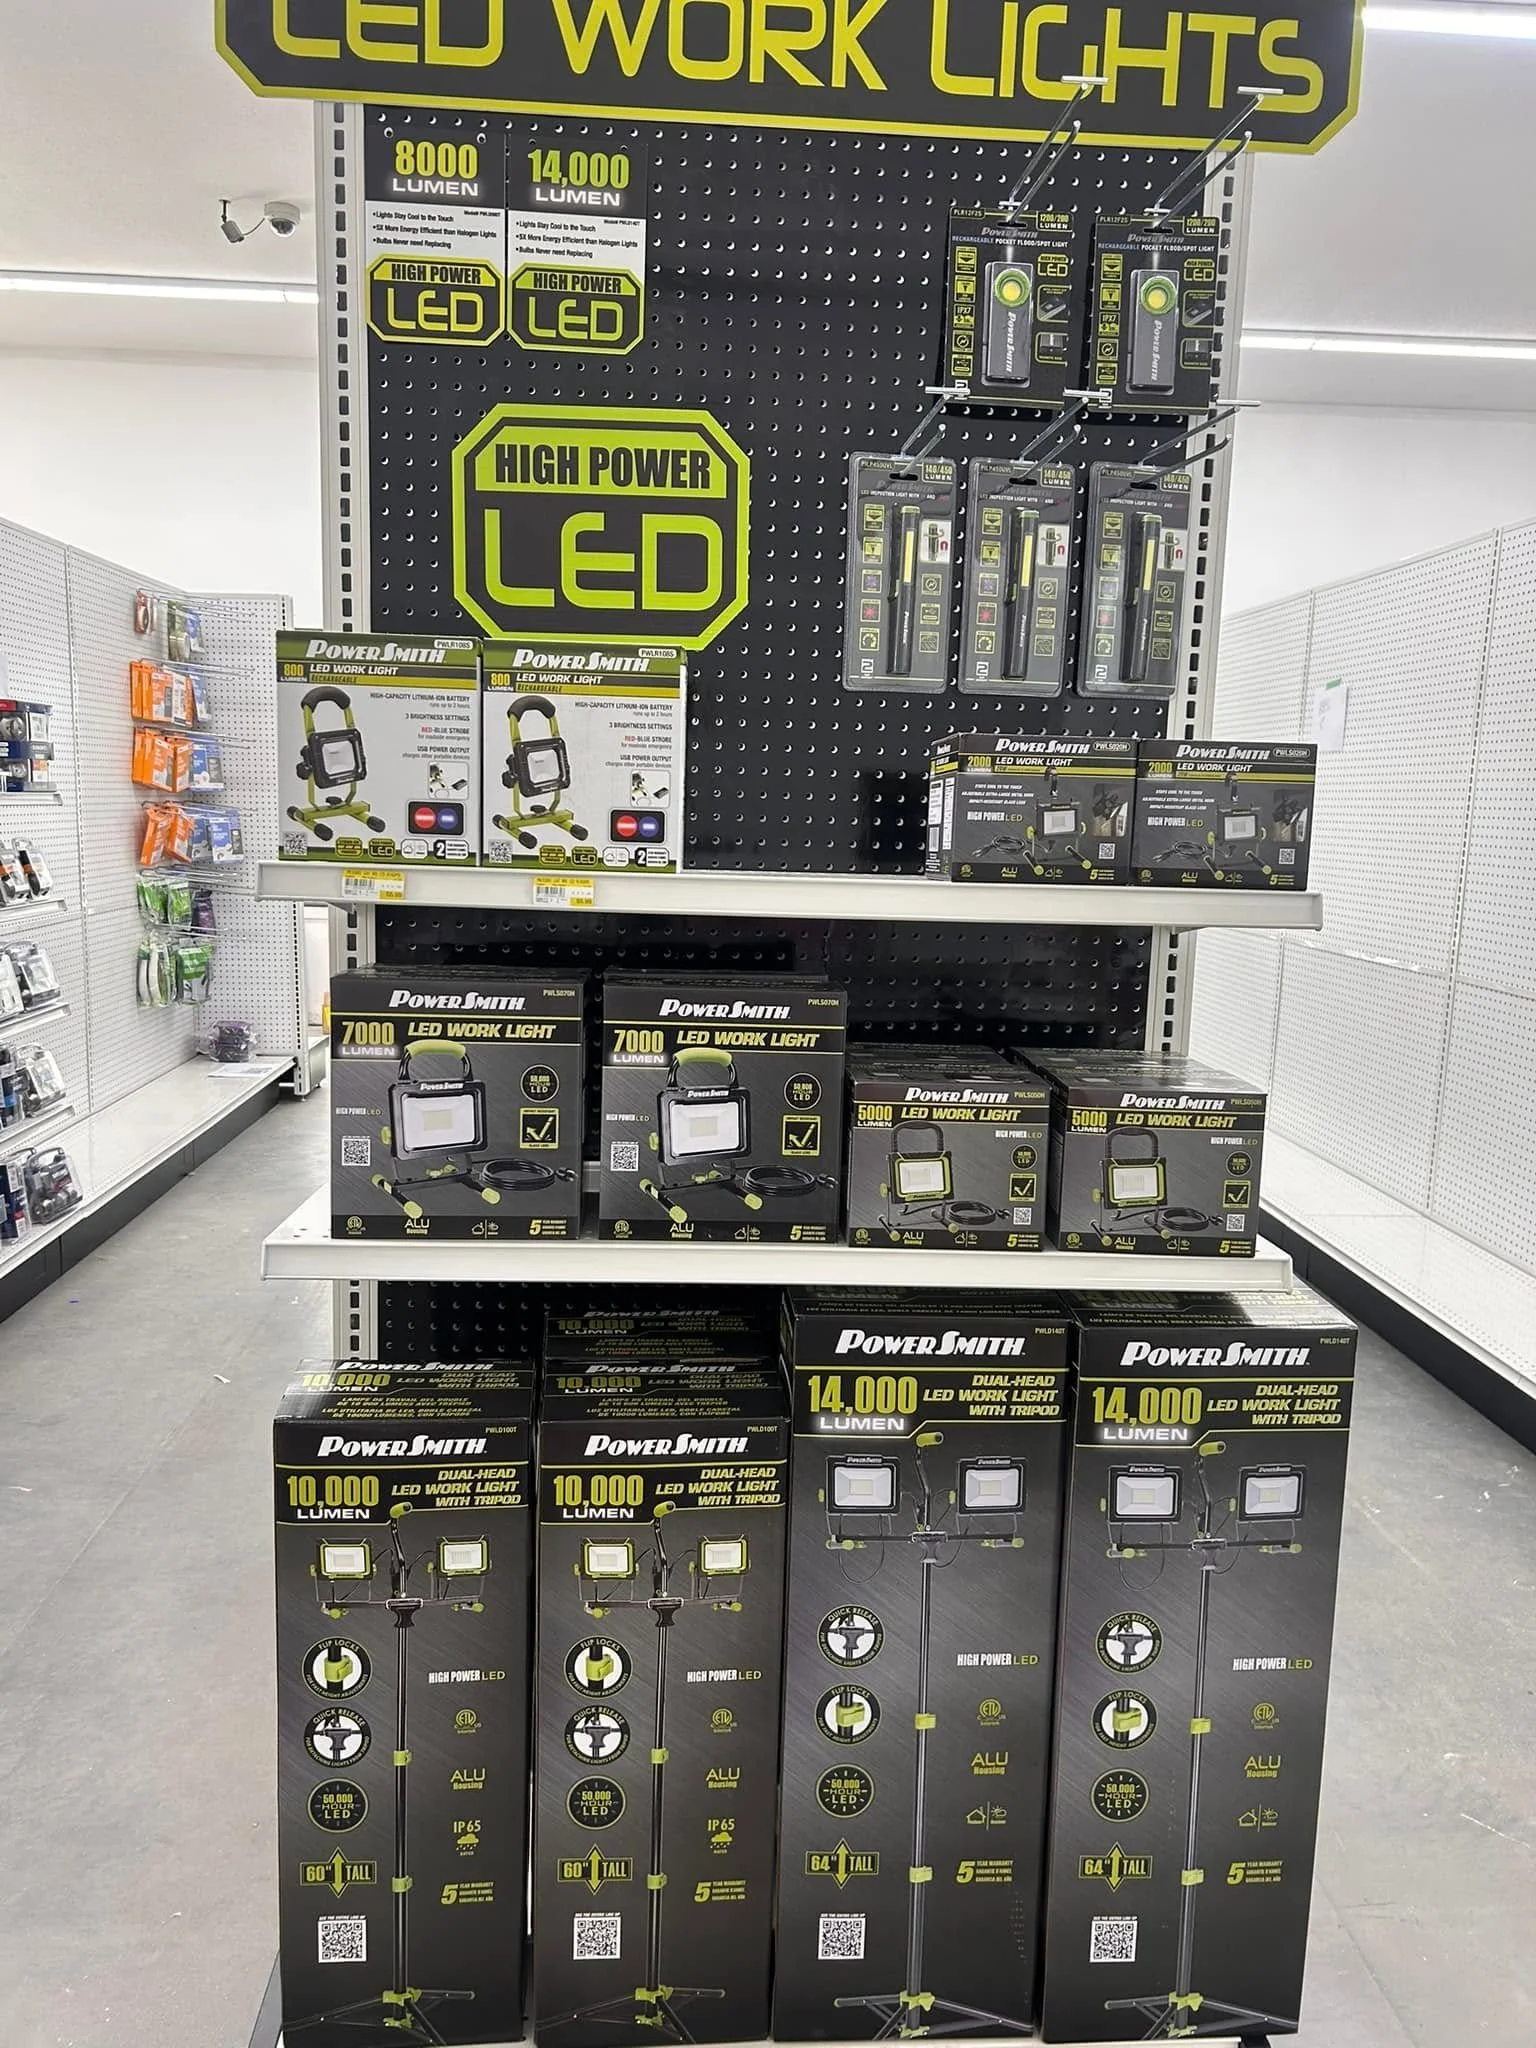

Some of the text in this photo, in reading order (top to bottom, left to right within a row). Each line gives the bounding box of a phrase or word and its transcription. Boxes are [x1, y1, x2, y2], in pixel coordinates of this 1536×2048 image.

[272, 0, 1324, 114] LED WORK LIGHTS
[395, 140, 478, 179] 8000
[528, 149, 630, 190] 14,000
[392, 178, 478, 197] LUMEN
[535, 187, 621, 206] LUMEN
[520, 221, 536, 229] Lights
[580, 224, 596, 232] Touch
[543, 235, 560, 243] Energy
[562, 236, 584, 244] Efficient
[599, 239, 620, 247] Halogen
[622, 240, 637, 248] Lights
[1018, 239, 1050, 247] FLOOD/SPOT
[1163, 244, 1197, 252] FLOOD/SPOT
[567, 250, 593, 258] Replacing
[391, 263, 481, 285] HIGH POWER
[1038, 263, 1068, 277] LED
[1184, 268, 1214, 281] LED
[533, 273, 621, 293] HIGH POWER
[387, 287, 484, 333] LED
[528, 296, 624, 341] LED
[495, 443, 711, 489] HIGH POWER
[484, 508, 723, 611] LED
[283, 664, 399, 677] 800 LED WORK LIGHT
[490, 673, 603, 686] 800 LED WORK LIGHT
[967, 756, 1072, 768] 2000 LED WORK LIGHT
[1148, 761, 1173, 773] 2000
[967, 811, 1023, 823] HIGH POWER LED
[370, 846, 393, 857] LED
[436, 842, 445, 857] 2
[341, 1021, 557, 1046] 7000 LED WORK LIGHT
[613, 1030, 820, 1053] 7000 LED WORK LIGHT
[341, 1047, 395, 1056] LUMEN
[858, 1105, 1021, 1121] 5000 LED WORK LIGHT
[1071, 1110, 1237, 1128] 5000 LED WORK LIGHT
[404, 1218, 430, 1228] ALU
[529, 1220, 542, 1235] 5
[972, 1375, 1056, 1387] DUAL-HEAD
[808, 1375, 918, 1416] 14,000
[923, 1390, 1058, 1402] LED WORK LIGHT
[969, 1405, 1060, 1416] WITH TRIPOD
[1092, 1386, 1202, 1427] 14,000
[1207, 1399, 1340, 1412] LED WORK LIGHT
[820, 1418, 905, 1431] LUMEN
[1104, 1428, 1188, 1441] LUMEN
[438, 1468, 516, 1481] DUAL-HEAD
[287, 1475, 380, 1509] 10,000
[391, 1481, 520, 1496] LED WORK LIGHT
[553, 1474, 644, 1508] 10,000
[435, 1494, 522, 1508] WITH TRIPOD
[297, 1509, 370, 1520] LUMEN
[563, 1508, 634, 1519] LUMEN
[957, 1653, 1038, 1667] HIGH POWER LED
[428, 1670, 505, 1683] HIGH POWER LED
[450, 1768, 485, 1782] ALU
[322, 1794, 353, 1804] 50,000
[322, 1803, 355, 1811] HOUR
[324, 1810, 351, 1819] LED
[453, 1820, 481, 1832] IP 65
[810, 1856, 873, 1872] 64" TALL
[305, 1864, 371, 1882] 60" TALL
